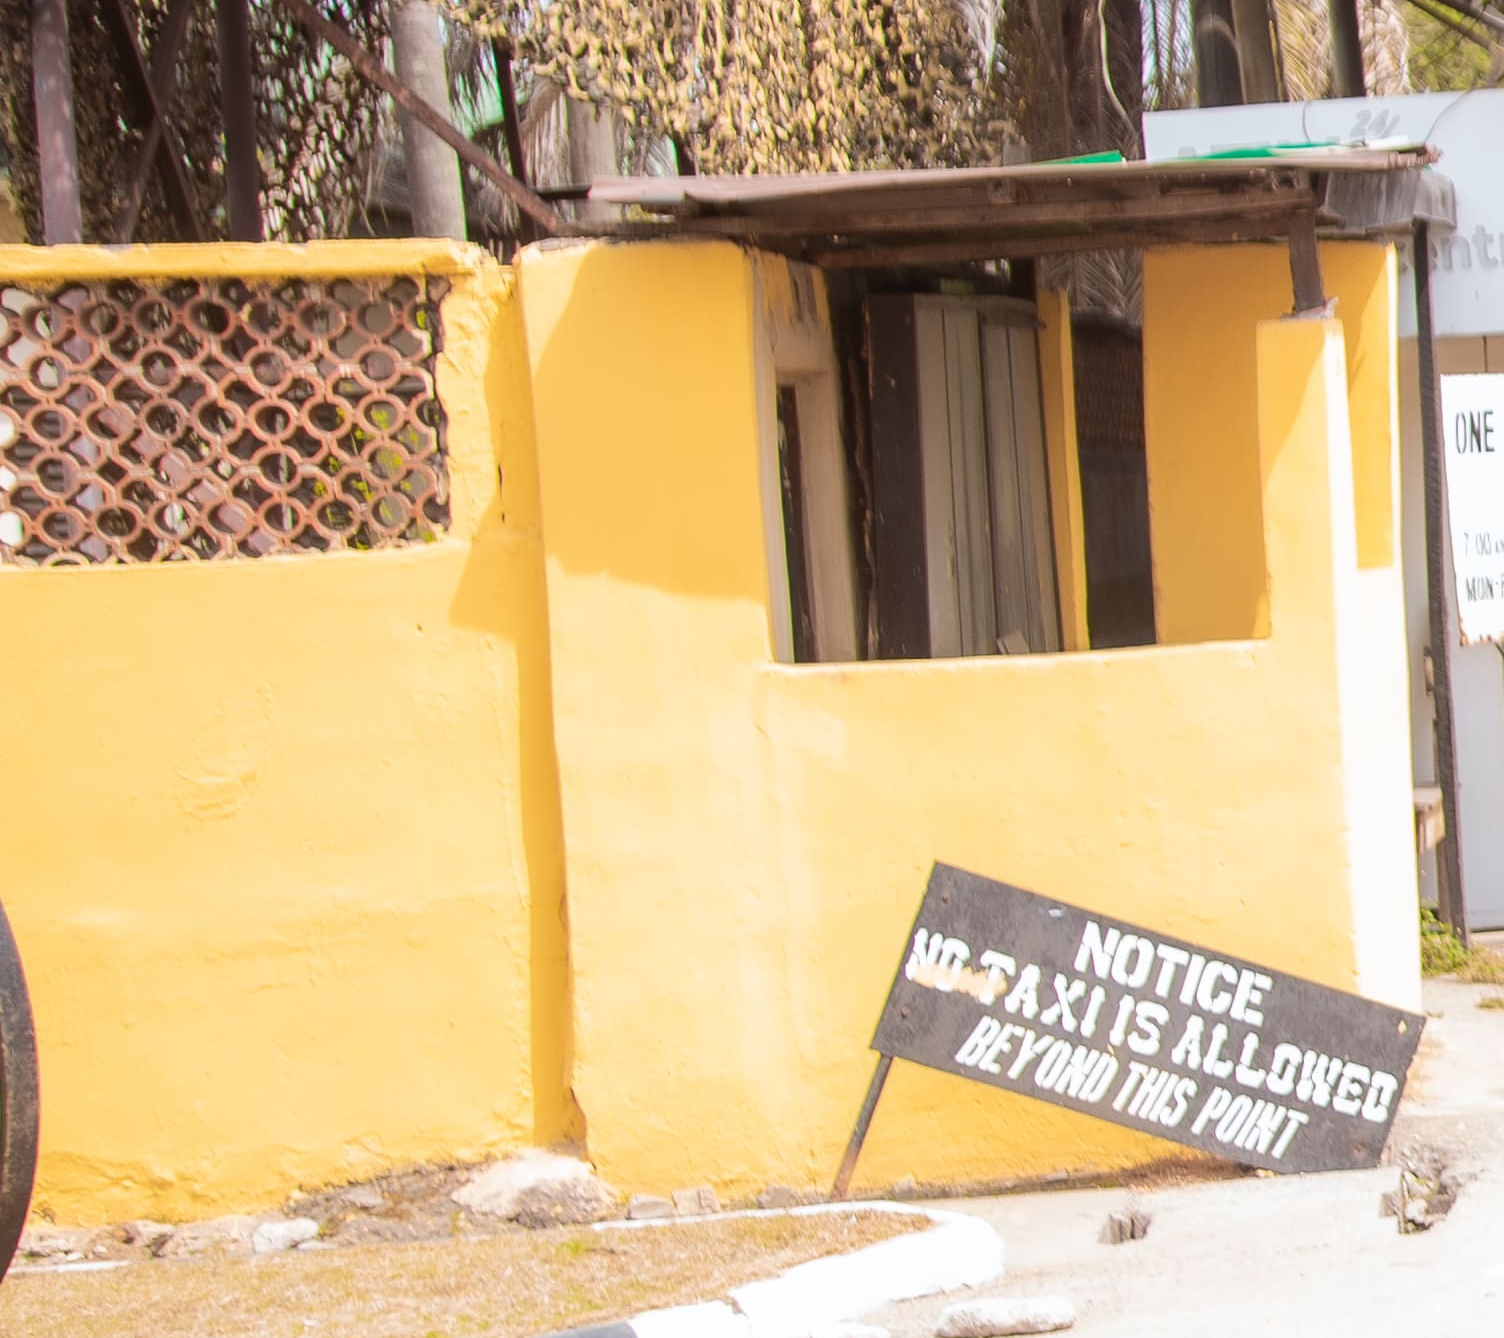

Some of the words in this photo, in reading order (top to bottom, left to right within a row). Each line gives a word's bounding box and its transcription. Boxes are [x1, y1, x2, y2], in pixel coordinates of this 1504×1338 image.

[1456, 409, 1495, 454] ONE
[904, 928, 971, 993] NO
[977, 949, 1106, 1039] TAXI
[1108, 995, 1170, 1056] IS
[1171, 1015, 1400, 1124] ALLOWED
[1072, 921, 1274, 1027] NOTICE
[954, 1016, 1120, 1106] BEYOND
[1112, 1059, 1198, 1128] THIS
[1189, 1086, 1309, 1159] POINT
